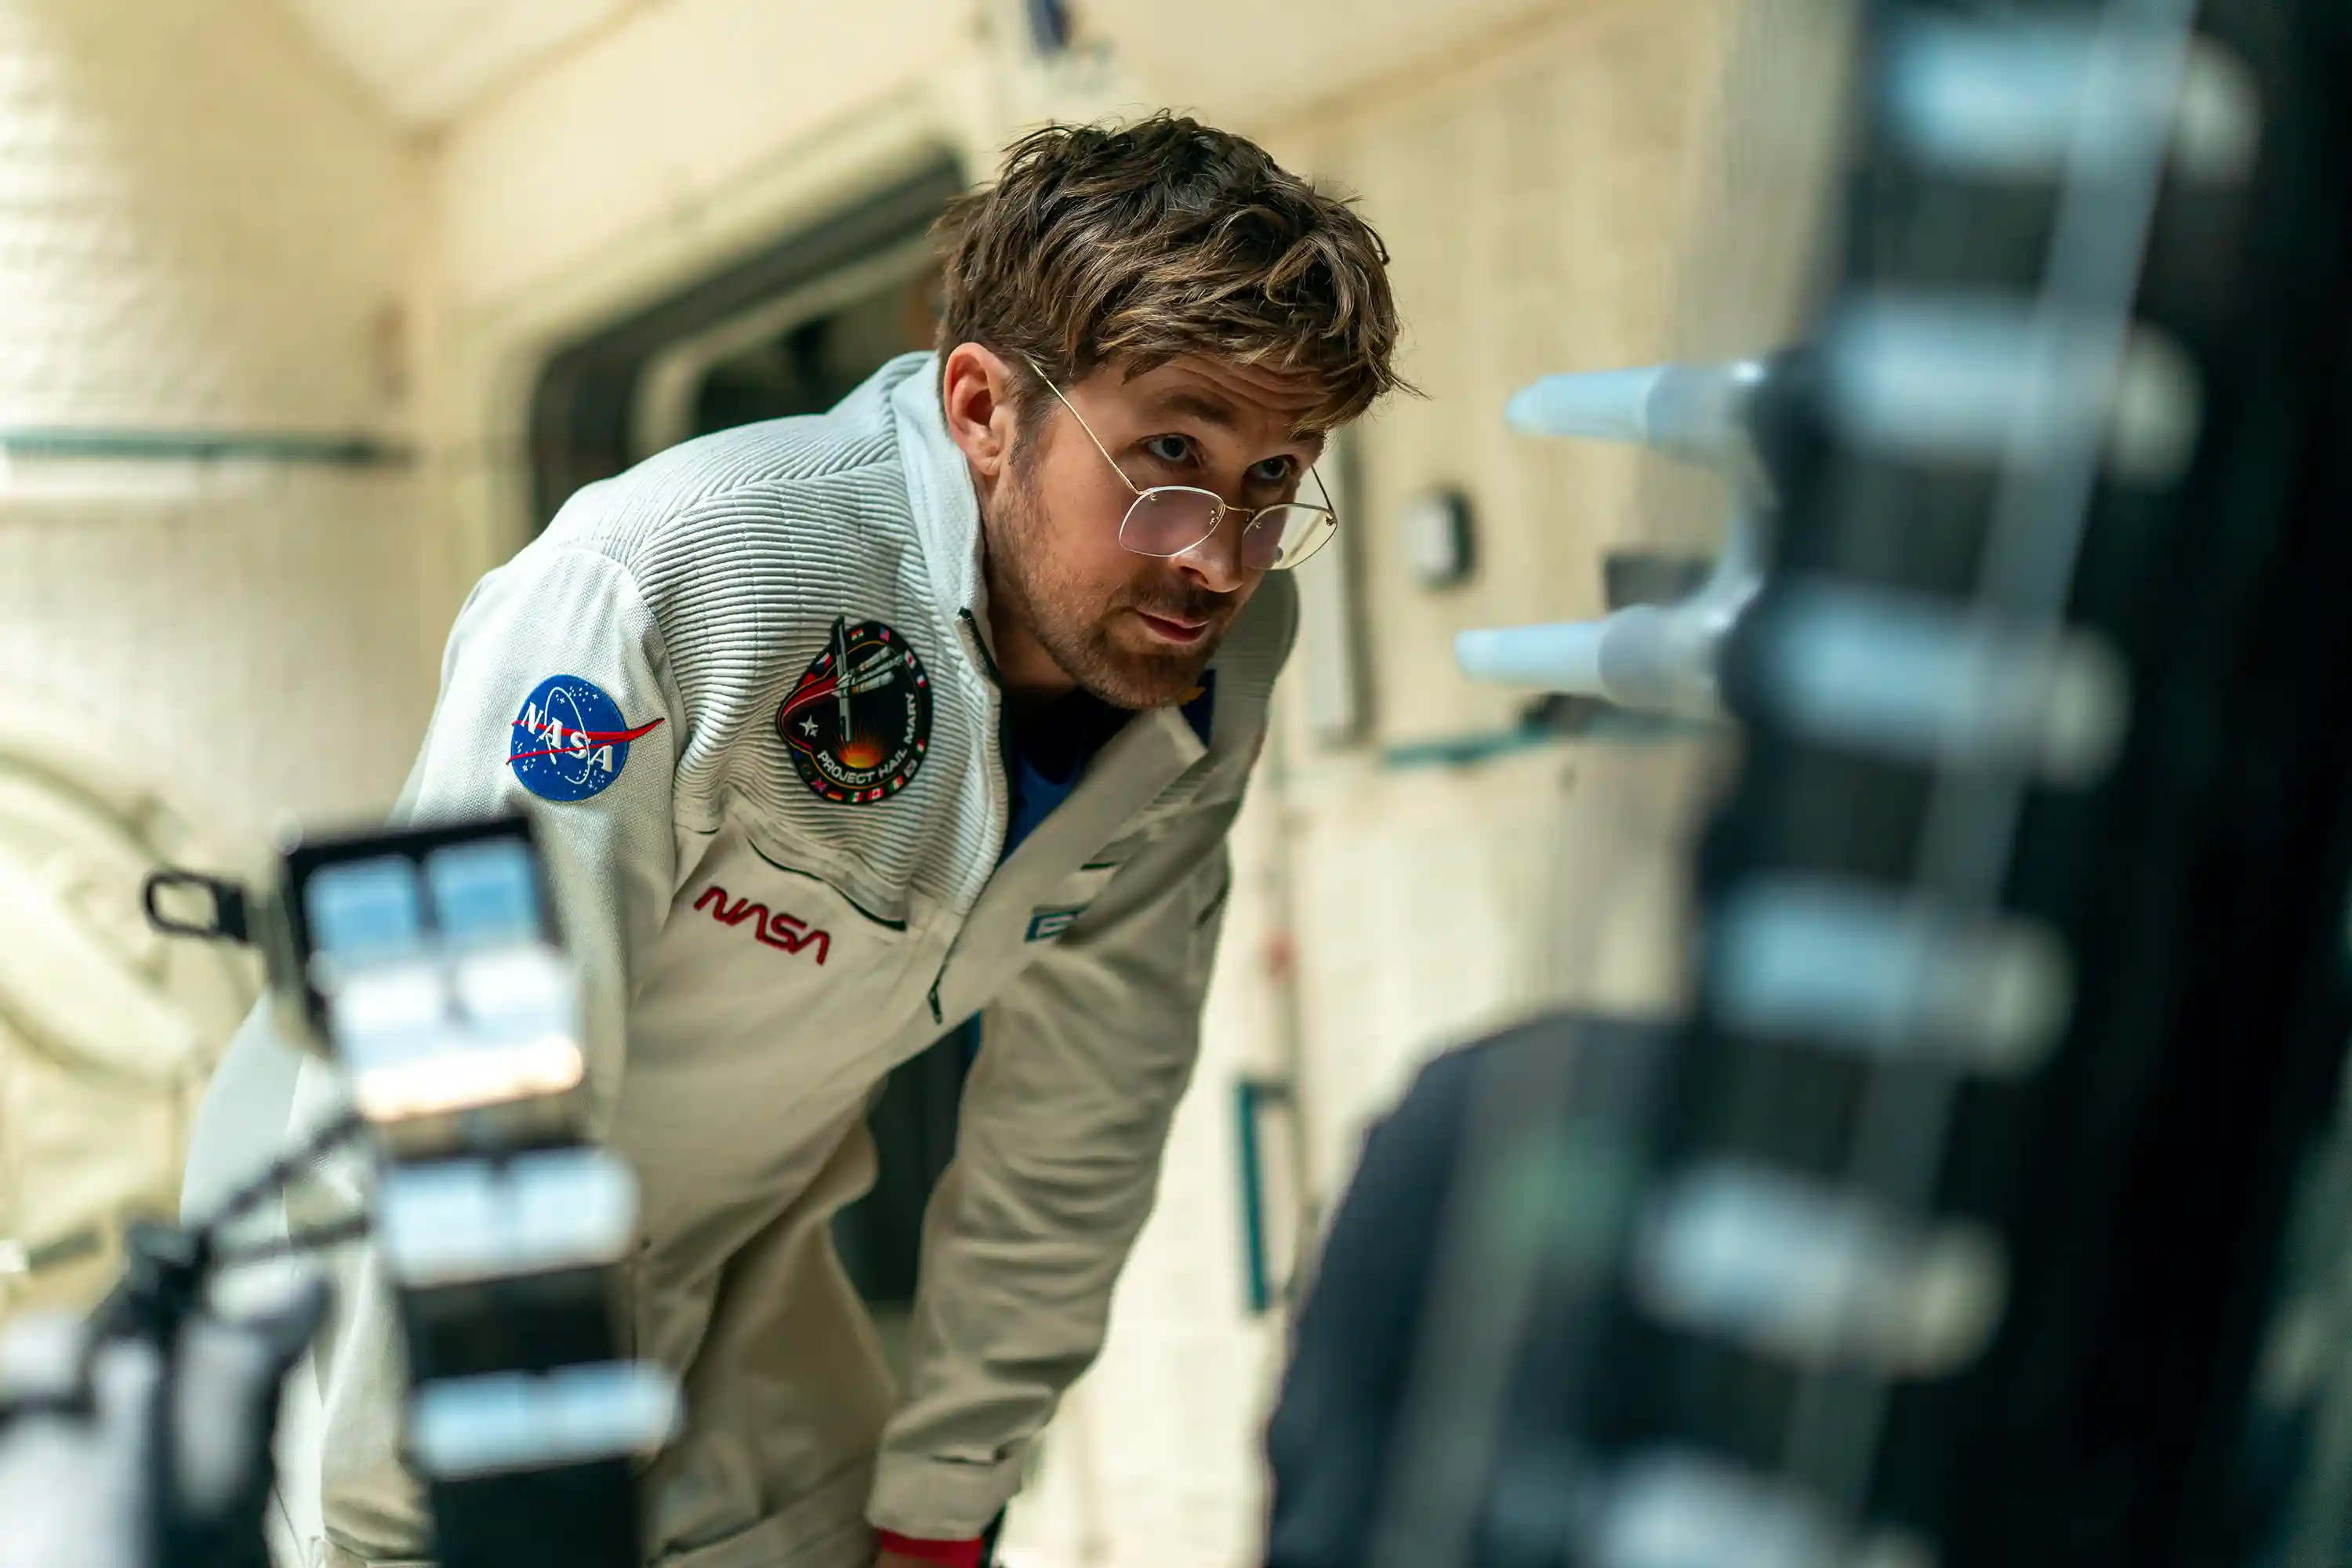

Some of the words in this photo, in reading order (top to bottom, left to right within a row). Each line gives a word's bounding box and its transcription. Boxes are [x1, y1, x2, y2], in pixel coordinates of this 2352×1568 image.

[521, 702, 613, 772] NASA
[817, 750, 876, 784] PROJECT
[878, 748, 907, 779] HAIL
[903, 692, 916, 744] MARY
[694, 886, 829, 966] NASA
